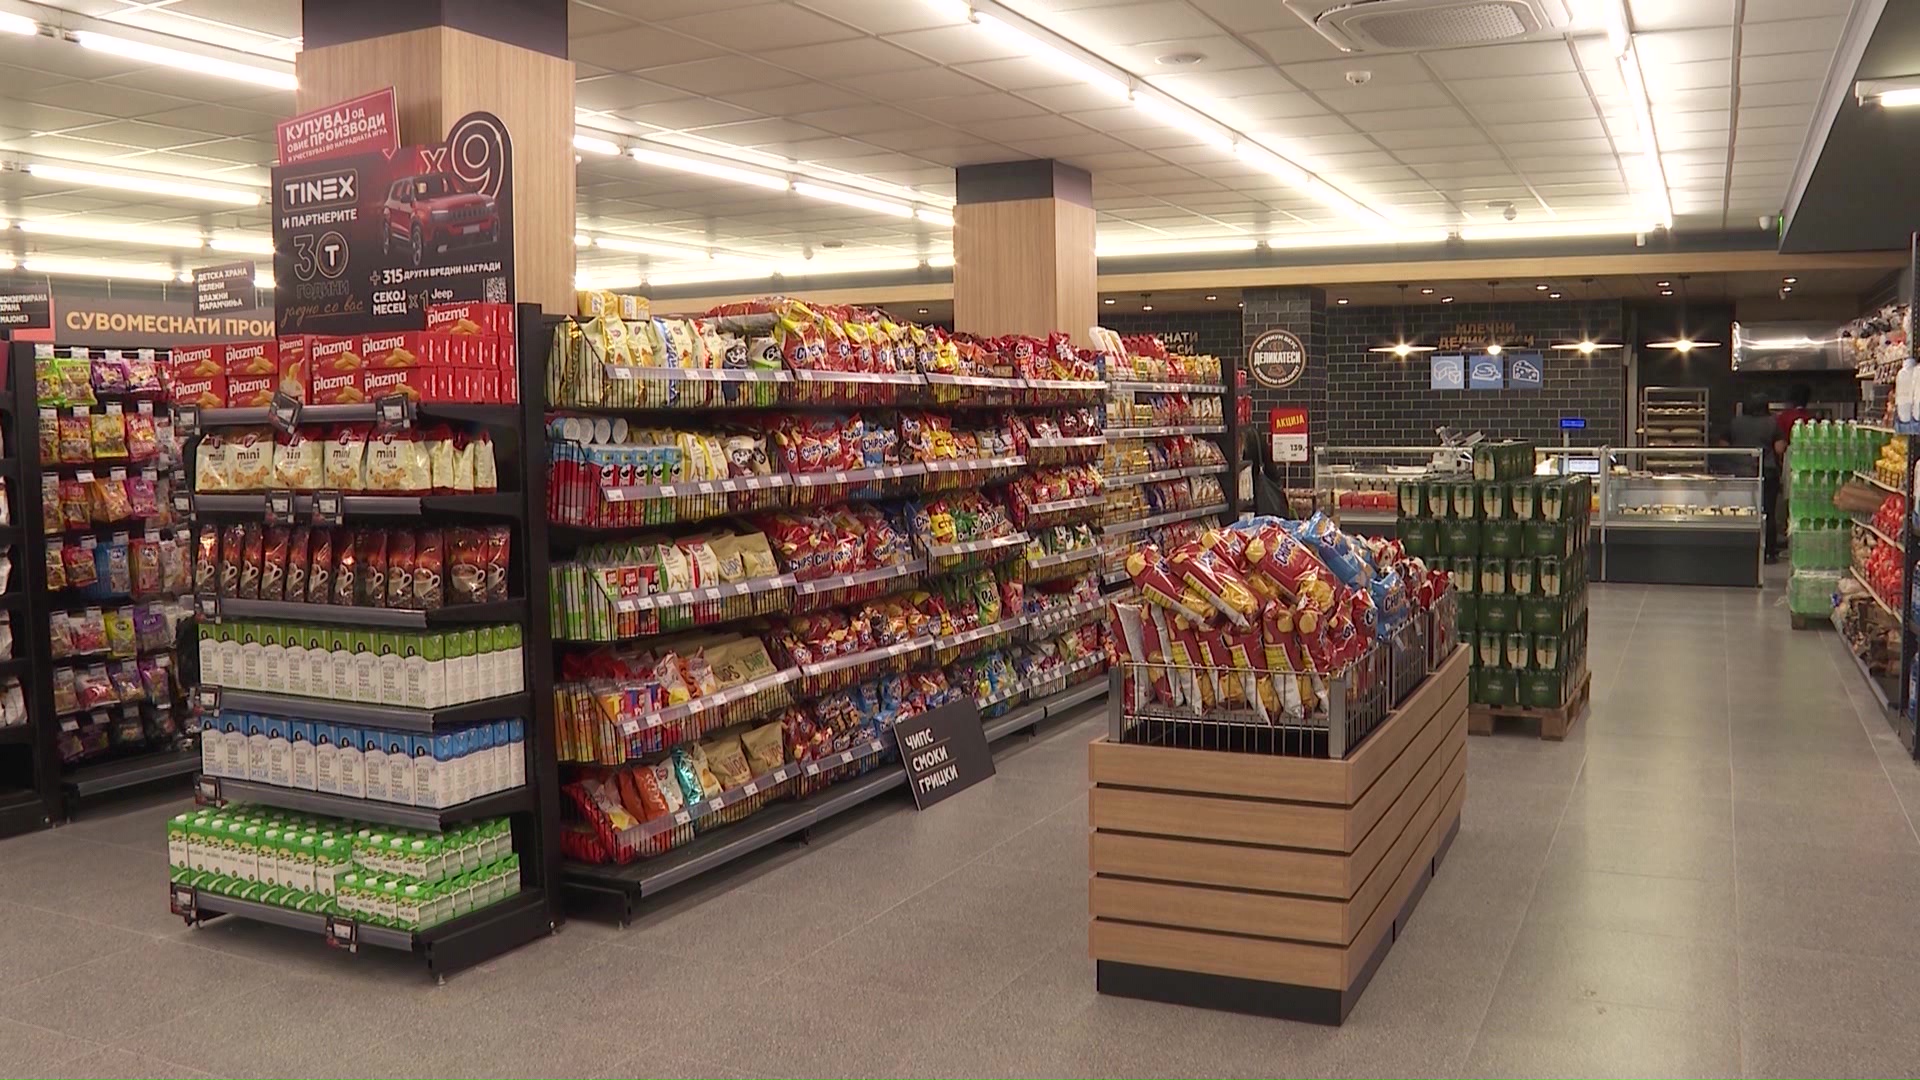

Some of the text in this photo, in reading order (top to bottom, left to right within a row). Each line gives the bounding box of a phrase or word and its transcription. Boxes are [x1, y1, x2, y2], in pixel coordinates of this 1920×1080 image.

[286, 108, 350, 141] КУПУВАЈ
[287, 113, 386, 153] ОВИЕ ПРОИЗВОДИ
[372, 128, 388, 138] ИГРА
[284, 175, 355, 205] TINEX
[282, 208, 358, 229] И ПАРТНЕРИТЕ
[198, 267, 248, 283] ДЕТСКА ХРАНА
[382, 268, 404, 284] 315
[403, 269, 430, 280] ДРУГИ
[430, 265, 462, 277] ВРЕДНИ
[463, 262, 501, 274] НАГРАДИ
[198, 292, 229, 303] ВЛАЖНИ
[296, 279, 350, 299] ГОДИНИ
[373, 290, 406, 304] СЕКОЈ
[431, 288, 454, 300] Jeep
[373, 302, 407, 315] МЕСЕЦ
[427, 307, 470, 327] plazma
[66, 311, 221, 335] СУВОМЕСНАТИ
[1455, 322, 1516, 335] МЛЕЧНИ
[226, 345, 264, 365] plazma
[280, 339, 304, 352] plazma
[312, 340, 352, 360] plazma
[362, 336, 405, 357] plazma
[174, 349, 211, 367] plazma
[1254, 351, 1301, 366] ДЕЛИКАТЕСИ
[175, 380, 211, 399] plazma
[229, 378, 270, 398] plazma
[313, 374, 355, 394] plazma
[364, 372, 407, 392] plazma
[1276, 414, 1305, 429] АКЦИЈА
[208, 450, 225, 461] mini
[237, 447, 260, 460] mini
[376, 446, 397, 458] mini
[1274, 538, 1296, 566] CHIPS
[905, 728, 934, 750] ЧИПС
[912, 745, 948, 772] СМОКИ
[918, 764, 959, 794] ГРИЦКИ
